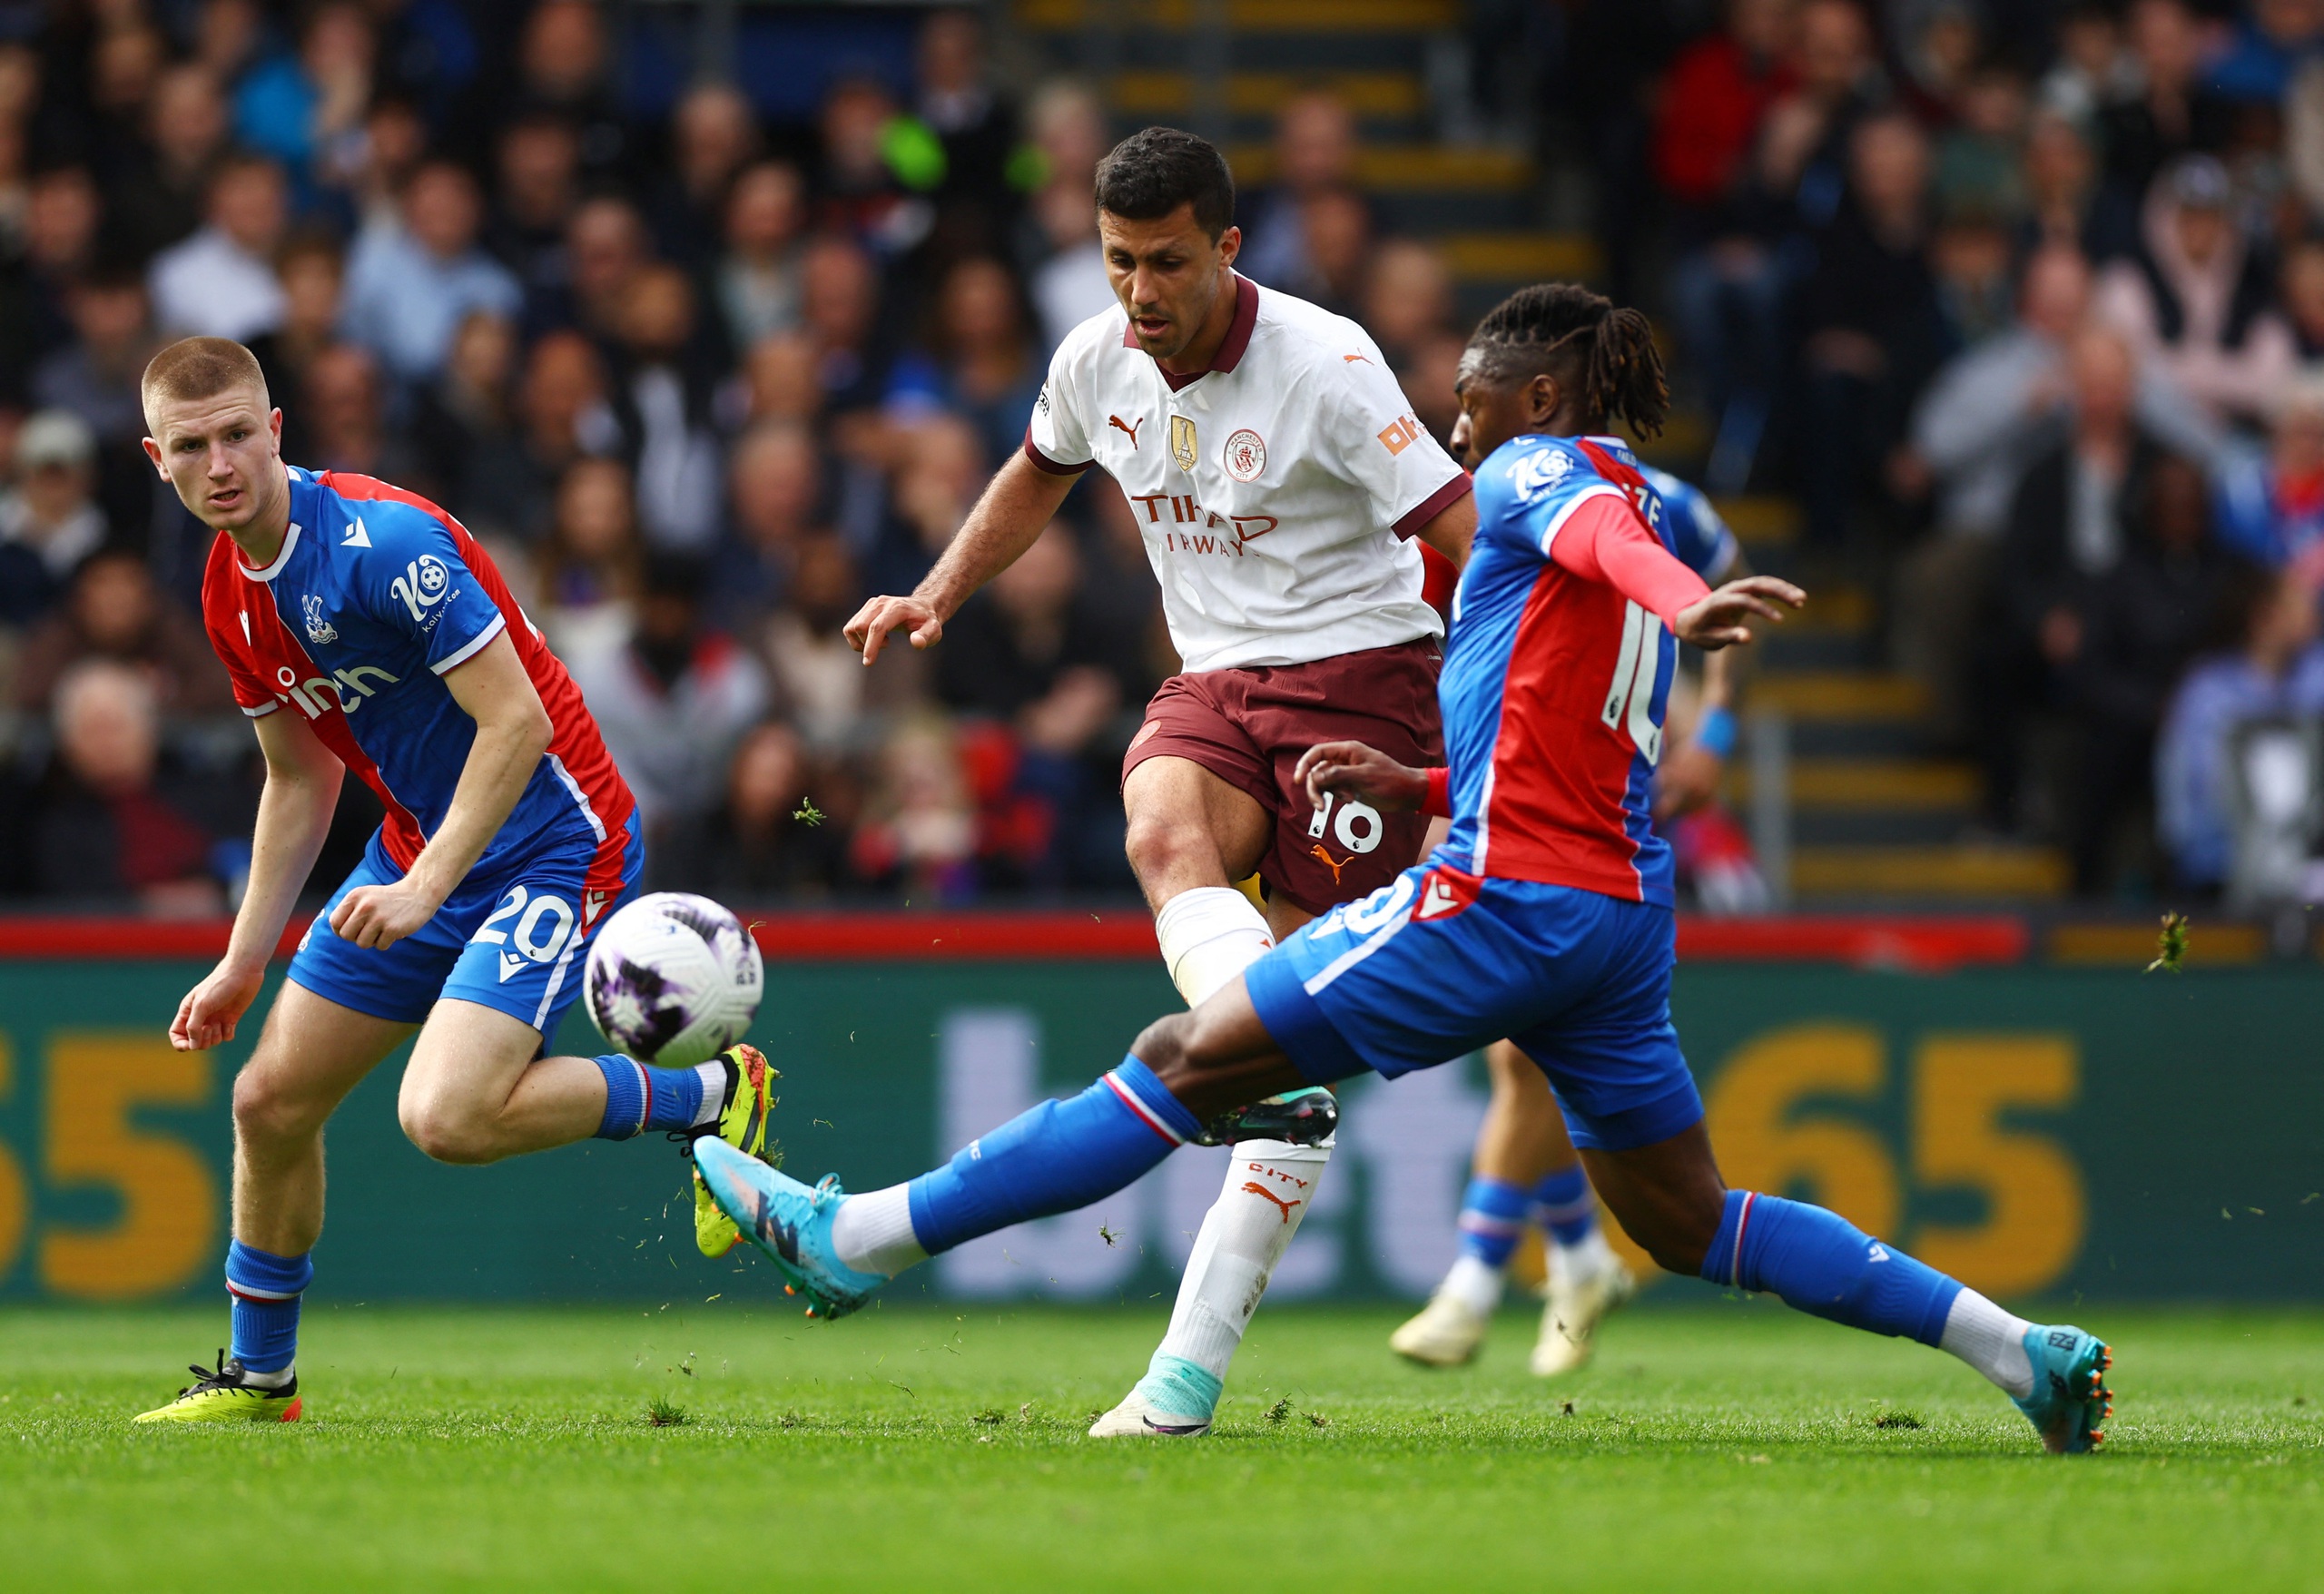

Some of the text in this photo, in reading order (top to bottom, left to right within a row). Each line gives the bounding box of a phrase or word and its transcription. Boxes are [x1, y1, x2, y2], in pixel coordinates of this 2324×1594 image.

[1230, 434, 1263, 453] MANCHESTER
[1377, 411, 1427, 457] OK
[421, 588, 461, 633] kaiy.com
[275, 665, 400, 721] inch
[470, 884, 575, 963] 20
[0, 1028, 218, 1300] 5
[1248, 1162, 1307, 1188] CITY
